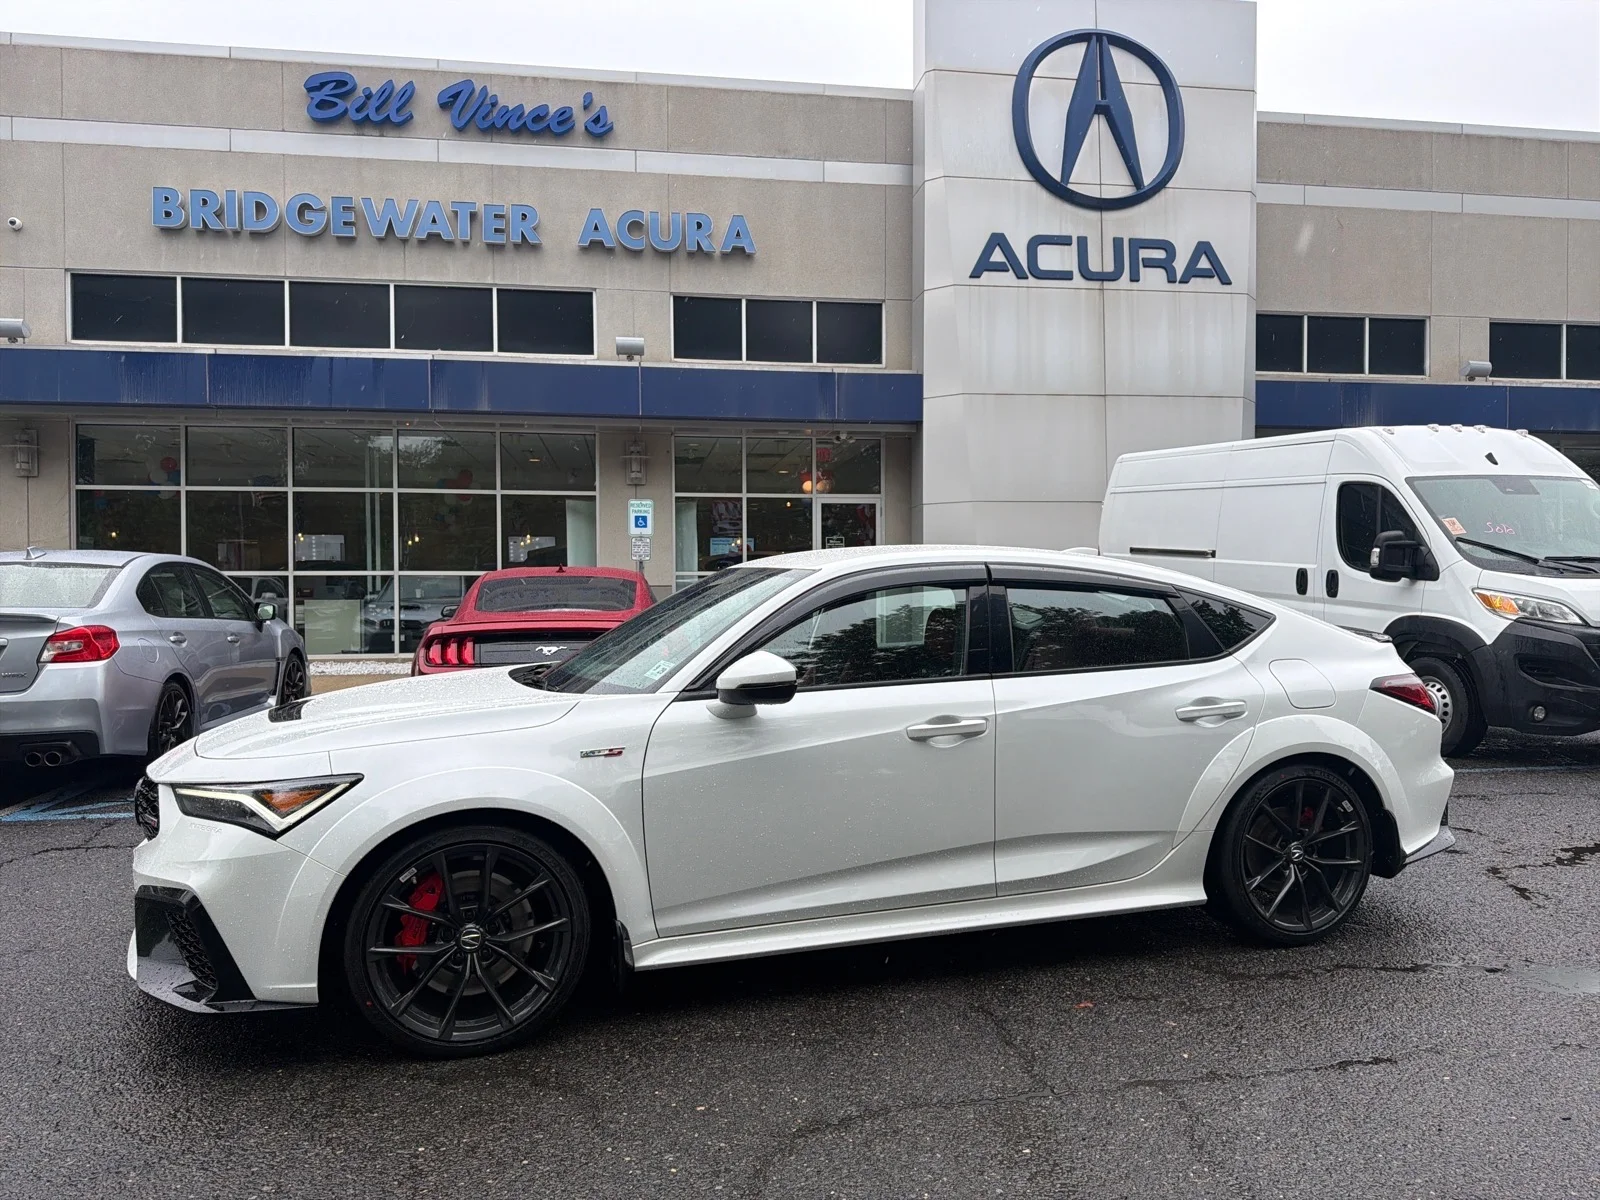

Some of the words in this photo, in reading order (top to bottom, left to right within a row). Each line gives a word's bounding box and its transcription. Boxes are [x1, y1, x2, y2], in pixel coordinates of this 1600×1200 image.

[304, 70, 416, 126] Bill
[437, 78, 614, 138] Vince's
[151, 186, 541, 246] BRIDGEWATER
[578, 208, 757, 256] ACURA
[969, 232, 1232, 285] ACURA
